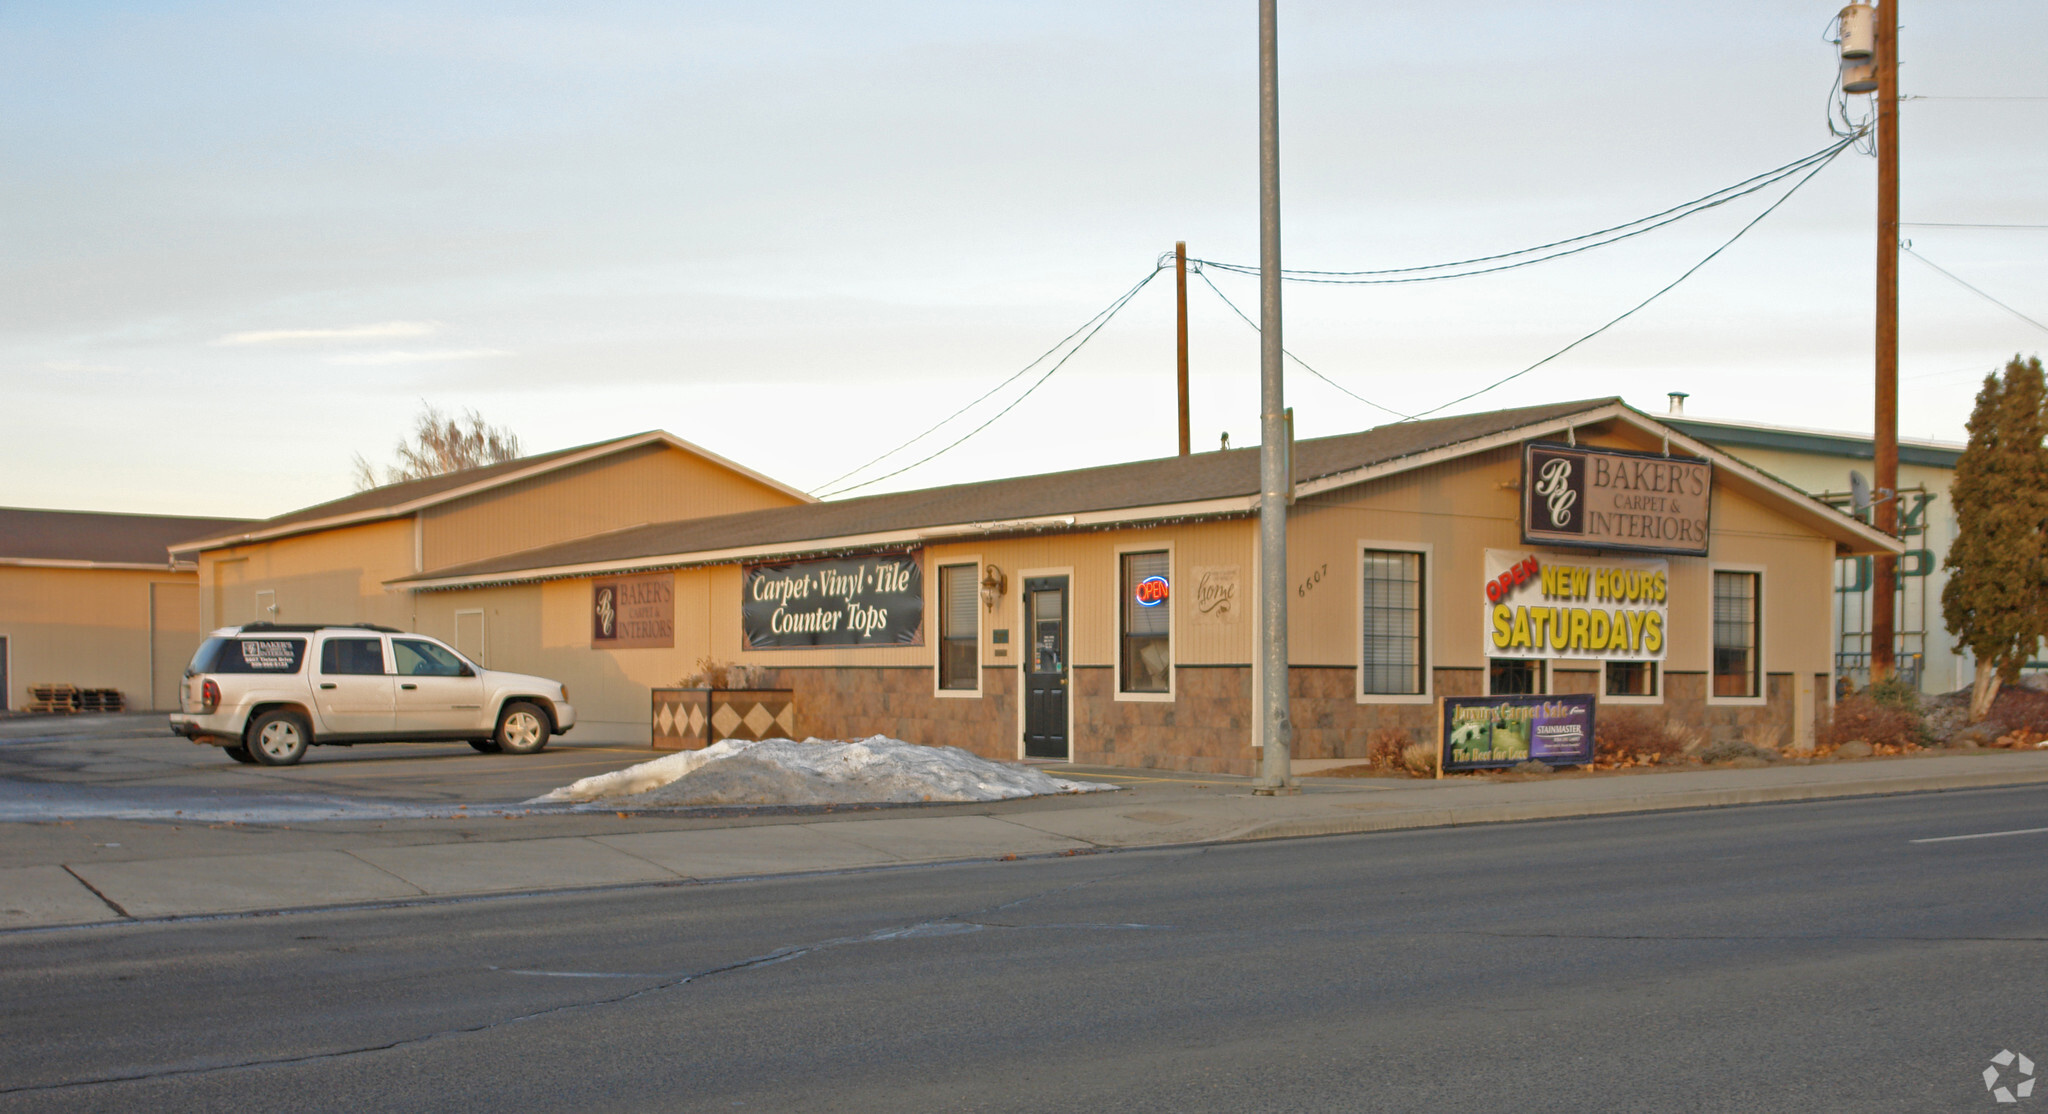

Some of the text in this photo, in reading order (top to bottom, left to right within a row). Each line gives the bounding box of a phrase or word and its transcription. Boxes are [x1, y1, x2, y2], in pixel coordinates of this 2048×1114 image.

[1593, 456, 1704, 497] BAKER'S
[1614, 493, 1681, 513] CARPET &
[1588, 510, 1706, 543] INTERIORS
[620, 581, 670, 605] BAKER'S
[752, 562, 911, 607] Carpet Vinyl Tile
[1136, 578, 1169, 602] OPEN
[1197, 571, 1235, 604] home
[1298, 563, 1328, 598] 6607
[1485, 554, 1539, 603] OPEN
[1541, 564, 1666, 602] NEW HOURS
[618, 619, 672, 640] INTERIORS
[771, 602, 888, 637] Counter Tops
[1491, 603, 1663, 653] SATURDAYS
[1454, 702, 1499, 723] Luxury
[1500, 701, 1540, 723] Carpet
[1543, 700, 1569, 719] Sale
[1536, 724, 1582, 735] STAINMASTER
[1453, 748, 1469, 763] The
[1471, 747, 1491, 762] Best
[1492, 746, 1506, 760] for
[1508, 746, 1529, 760] Less
